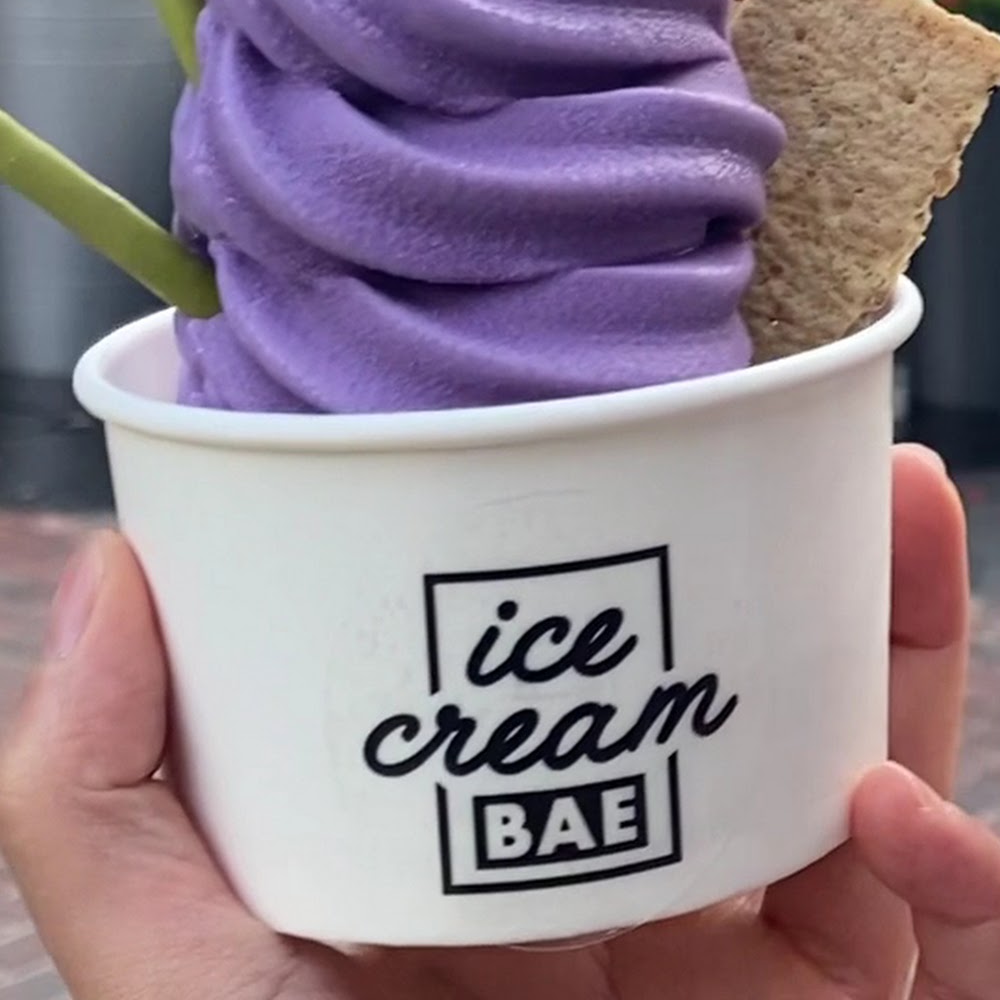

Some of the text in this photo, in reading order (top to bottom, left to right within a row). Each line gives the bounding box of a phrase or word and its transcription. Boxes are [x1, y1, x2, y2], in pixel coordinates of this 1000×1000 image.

[466, 600, 638, 686] ice
[363, 673, 738, 778] cream
[483, 784, 639, 861] BAE
